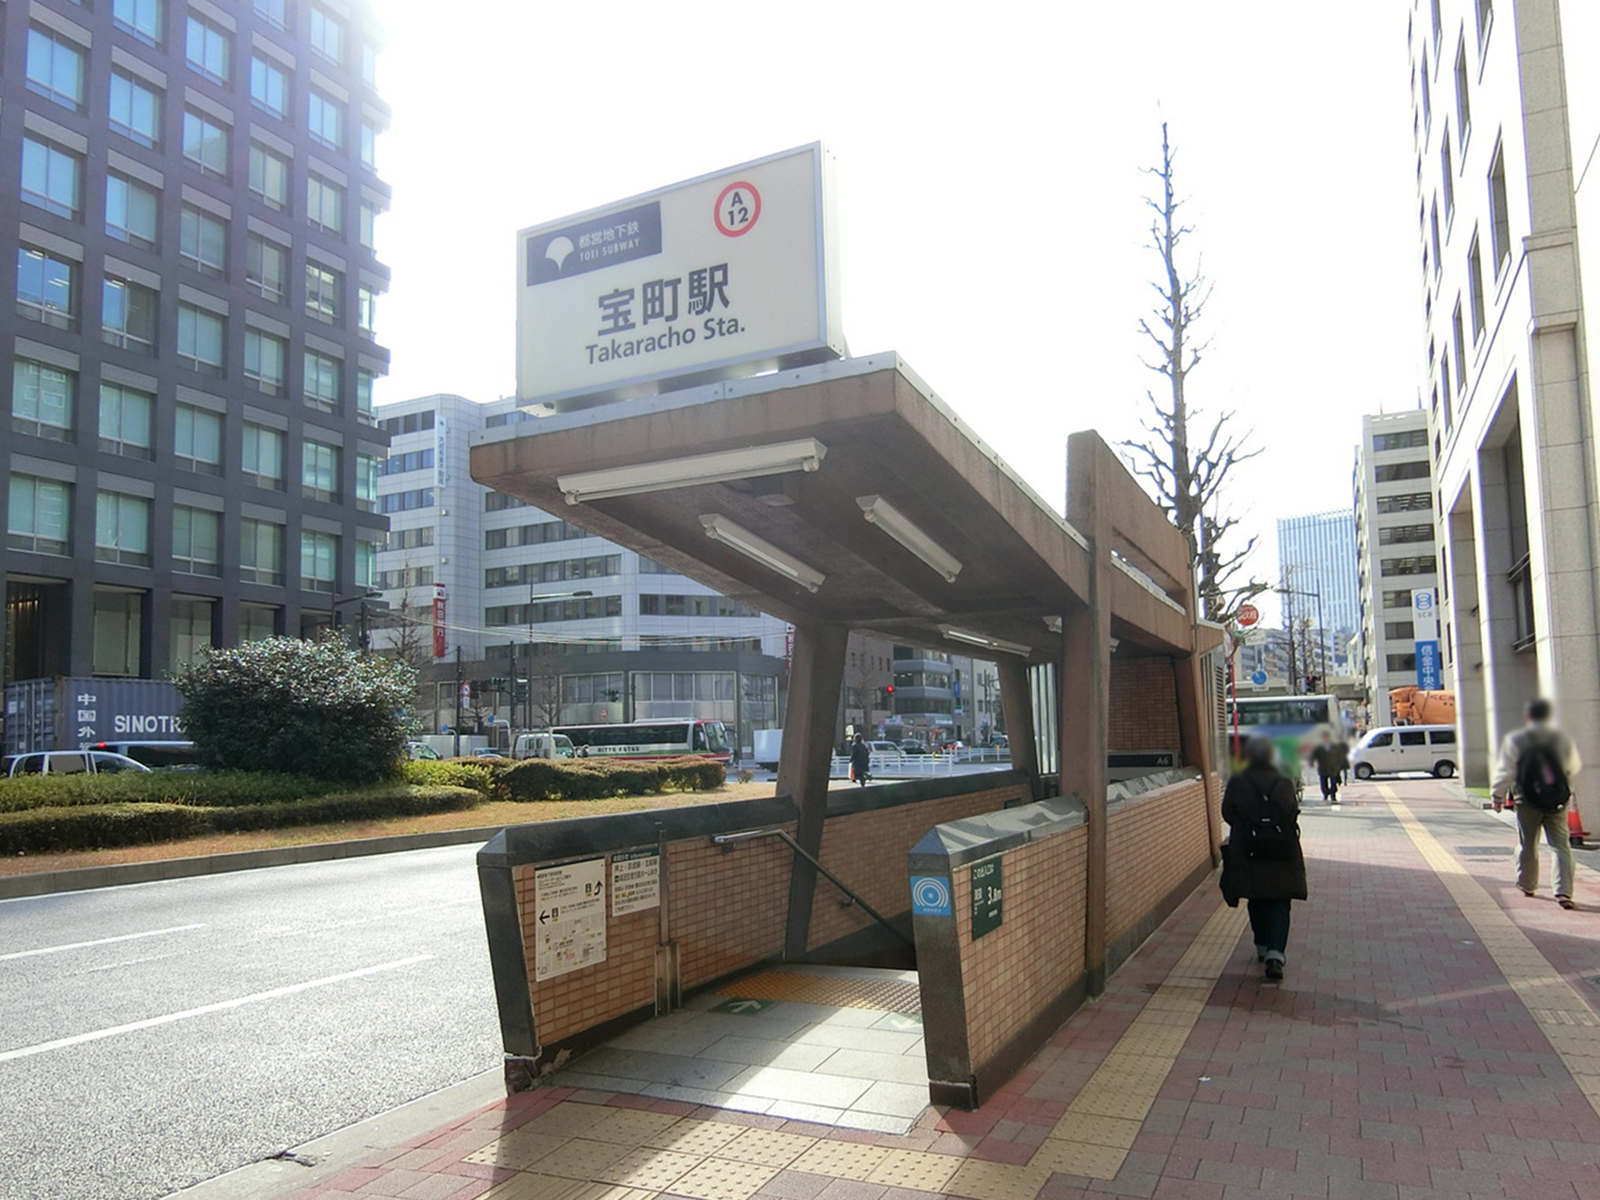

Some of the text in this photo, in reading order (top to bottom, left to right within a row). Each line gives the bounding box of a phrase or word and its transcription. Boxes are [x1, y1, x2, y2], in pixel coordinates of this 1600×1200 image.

[730, 191, 743, 207] A
[727, 207, 749, 226] 12
[579, 221, 640, 249] 都営地下鉄
[580, 237, 640, 262] TOEI SUBWAY
[597, 262, 730, 337] 宝町駅
[585, 317, 746, 365] Takaracho Sta.
[114, 715, 187, 733] SINOTR
